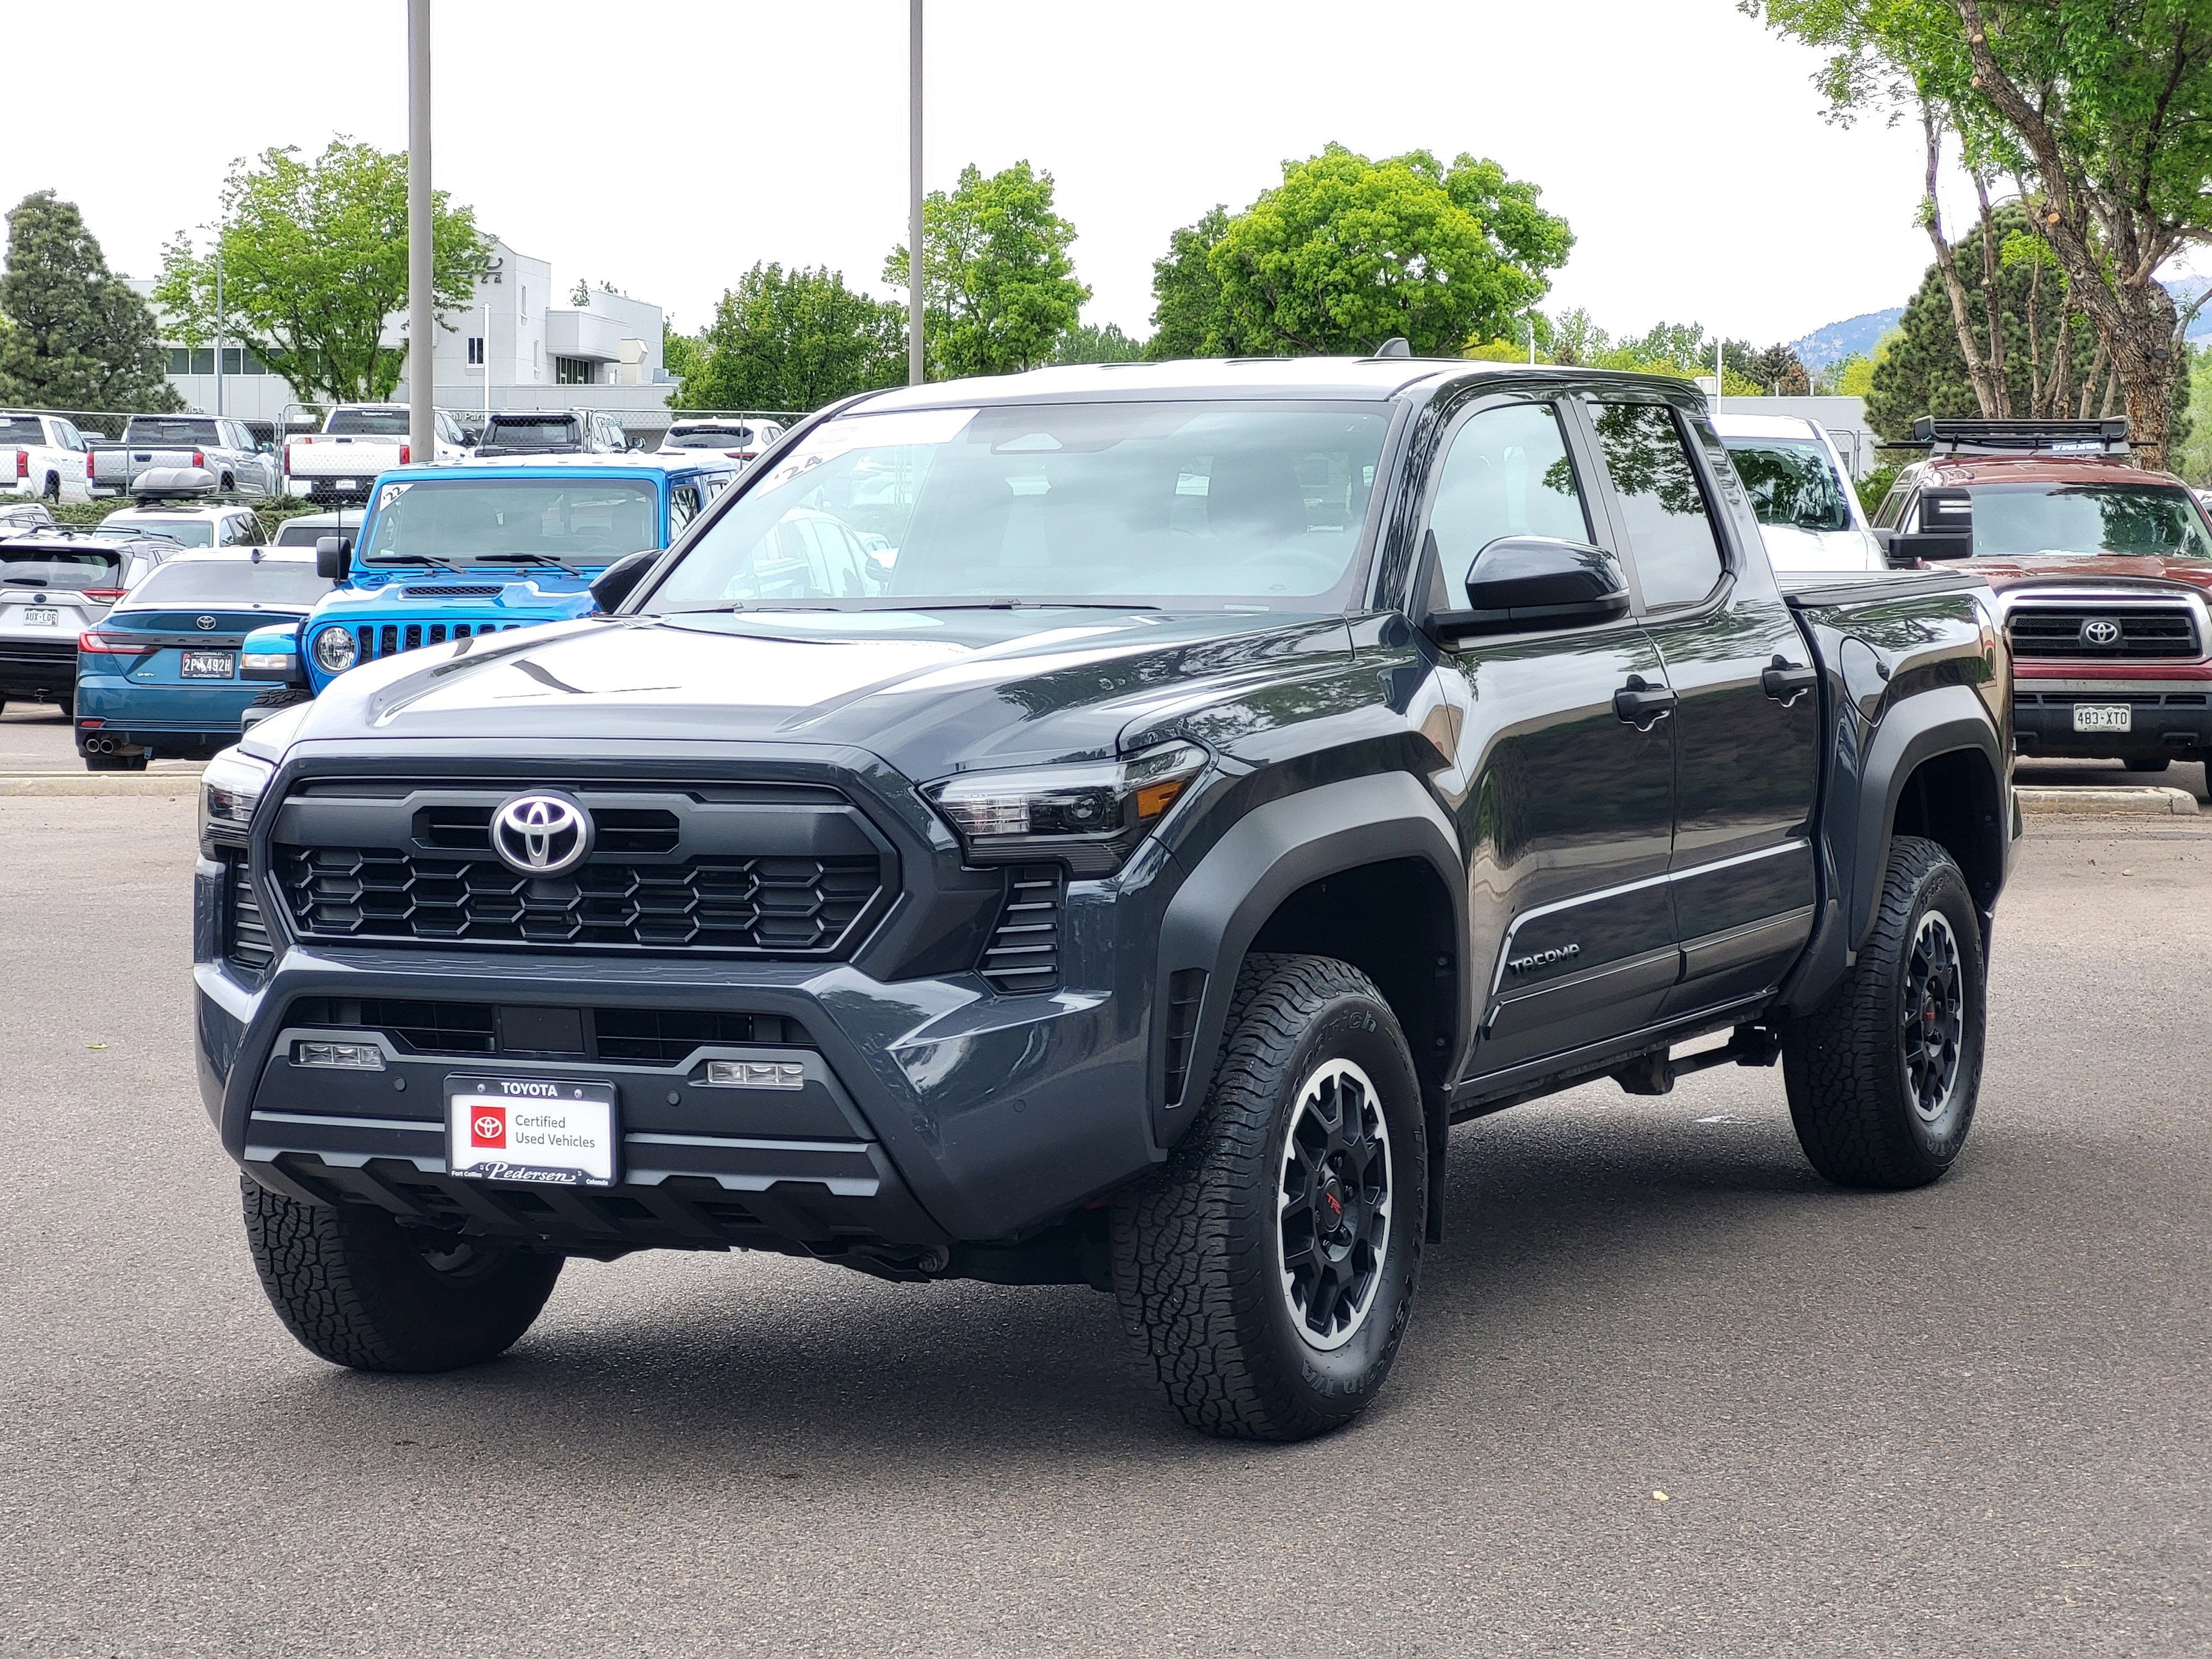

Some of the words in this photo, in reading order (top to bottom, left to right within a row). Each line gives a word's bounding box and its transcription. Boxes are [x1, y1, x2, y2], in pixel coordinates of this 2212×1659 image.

[2052, 442, 2101, 451] YAKIMA
[1506, 943, 1580, 973] TACOMA
[500, 1082, 559, 1097] TOYOTA
[515, 1115, 566, 1129] Certified
[515, 1132, 545, 1145] Used
[547, 1134, 596, 1148] Vehicles
[484, 1161, 576, 1182] Pedersen
